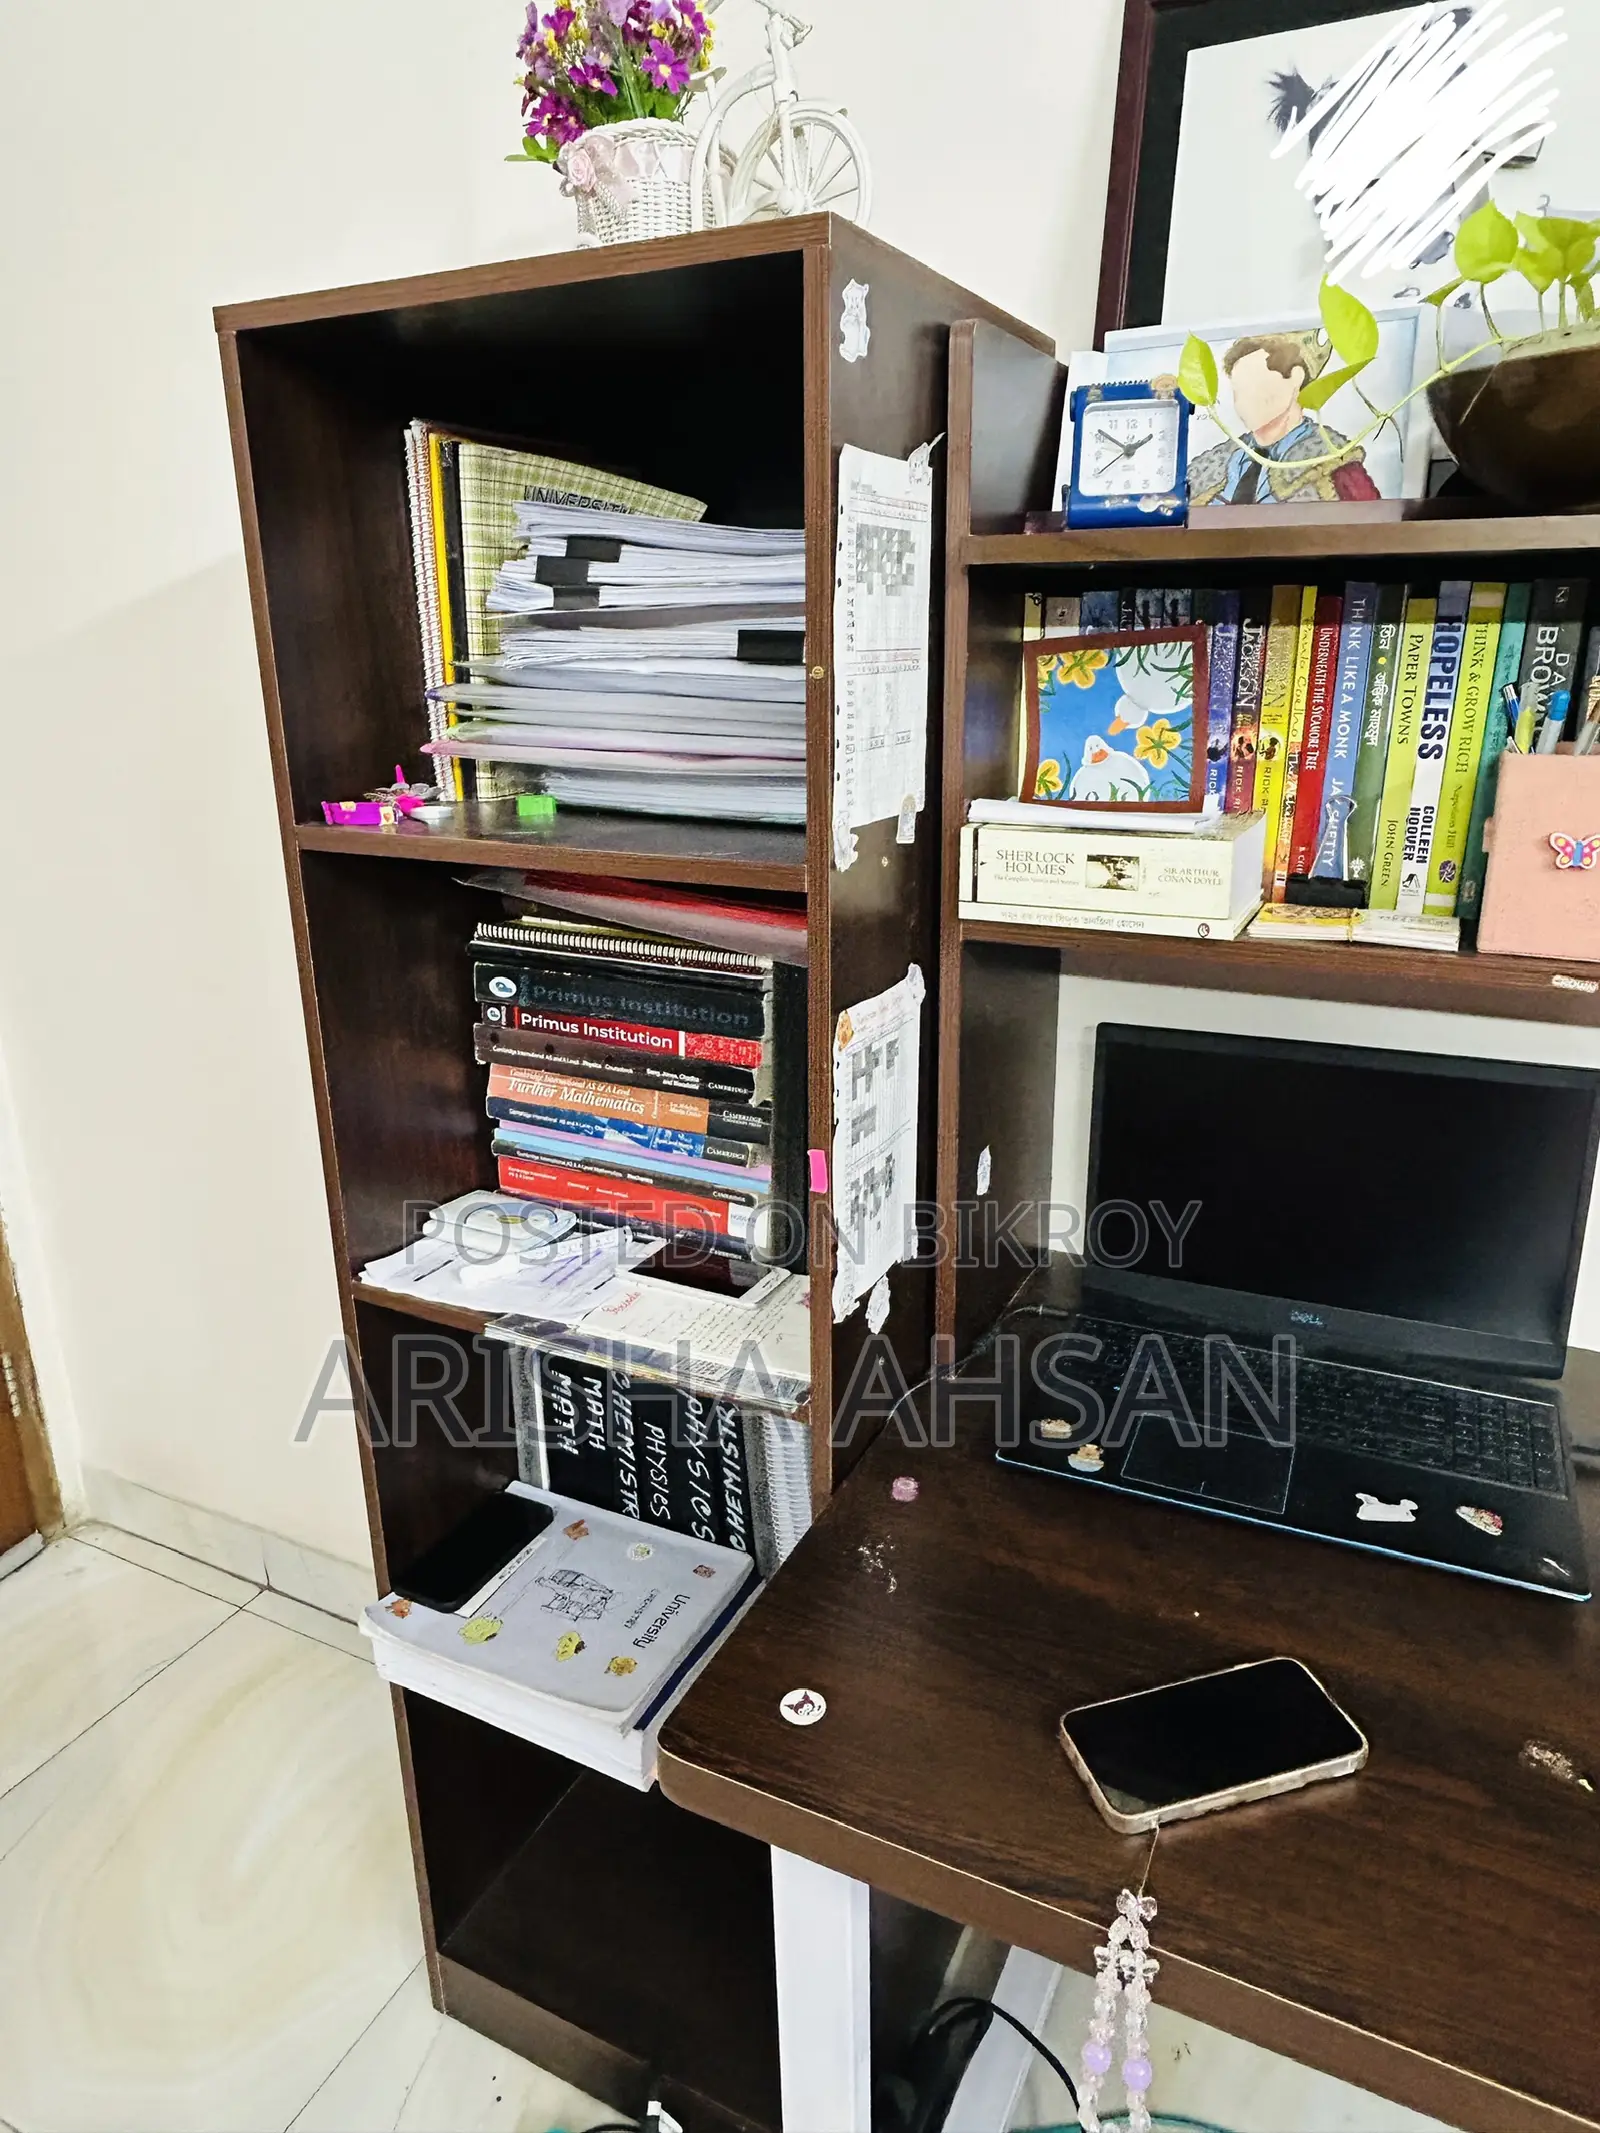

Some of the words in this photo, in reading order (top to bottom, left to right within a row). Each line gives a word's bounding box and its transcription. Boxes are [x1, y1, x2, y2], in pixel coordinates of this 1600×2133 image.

[1349, 598, 1366, 650] THINK
[1379, 623, 1396, 650] তিন
[1470, 621, 1488, 669] THINK
[1236, 618, 1263, 709] JACKSON
[1315, 627, 1334, 685] UNDERNEATH
[1343, 656, 1359, 690] LIKE
[1404, 634, 1424, 682] PAPER
[1291, 676, 1307, 738] Coelho
[1313, 687, 1325, 703] THE
[1340, 693, 1354, 704] A
[1417, 615, 1462, 760] HOPELESS
[1462, 685, 1479, 735] GROW
[1309, 703, 1325, 749] SYCAMORE
[1334, 711, 1352, 759] MONK
[1397, 685, 1418, 745] TOWNS
[1305, 749, 1318, 770] TREE
[1455, 737, 1472, 773] RICH
[1386, 820, 1399, 849] JOHN
[1402, 807, 1421, 861] HOOVER
[1416, 805, 1435, 864] COLLEEN
[996, 850, 1075, 865] SHERLOCK
[1005, 861, 1066, 876] HOLMES
[1158, 875, 1191, 884] CONAN
[1193, 877, 1223, 886] DOYLE
[1163, 867, 1177, 875] SIR
[1180, 868, 1220, 878] ARTHUR
[1381, 852, 1394, 887] GREEN
[533, 984, 612, 1009] Primus
[620, 996, 750, 1027] Institution
[520, 1012, 579, 1034] Primus
[583, 1022, 673, 1050] Institution
[508, 1078, 558, 1098] Further
[559, 1086, 645, 1114] Mathematics
[707, 1082, 749, 1095] CAMBRIDGE
[722, 1110, 762, 1123] CAMBRIDGE
[706, 1146, 745, 1160] CAMBRIDGE
[583, 1376, 606, 1451] MATH
[611, 1370, 640, 1520] CHEMISTR
[676, 1387, 716, 1543] PHYSICS
[643, 1421, 671, 1520] PHYSICS
[716, 1403, 747, 1552] CHEMISTR
[632, 1593, 691, 1649] University
